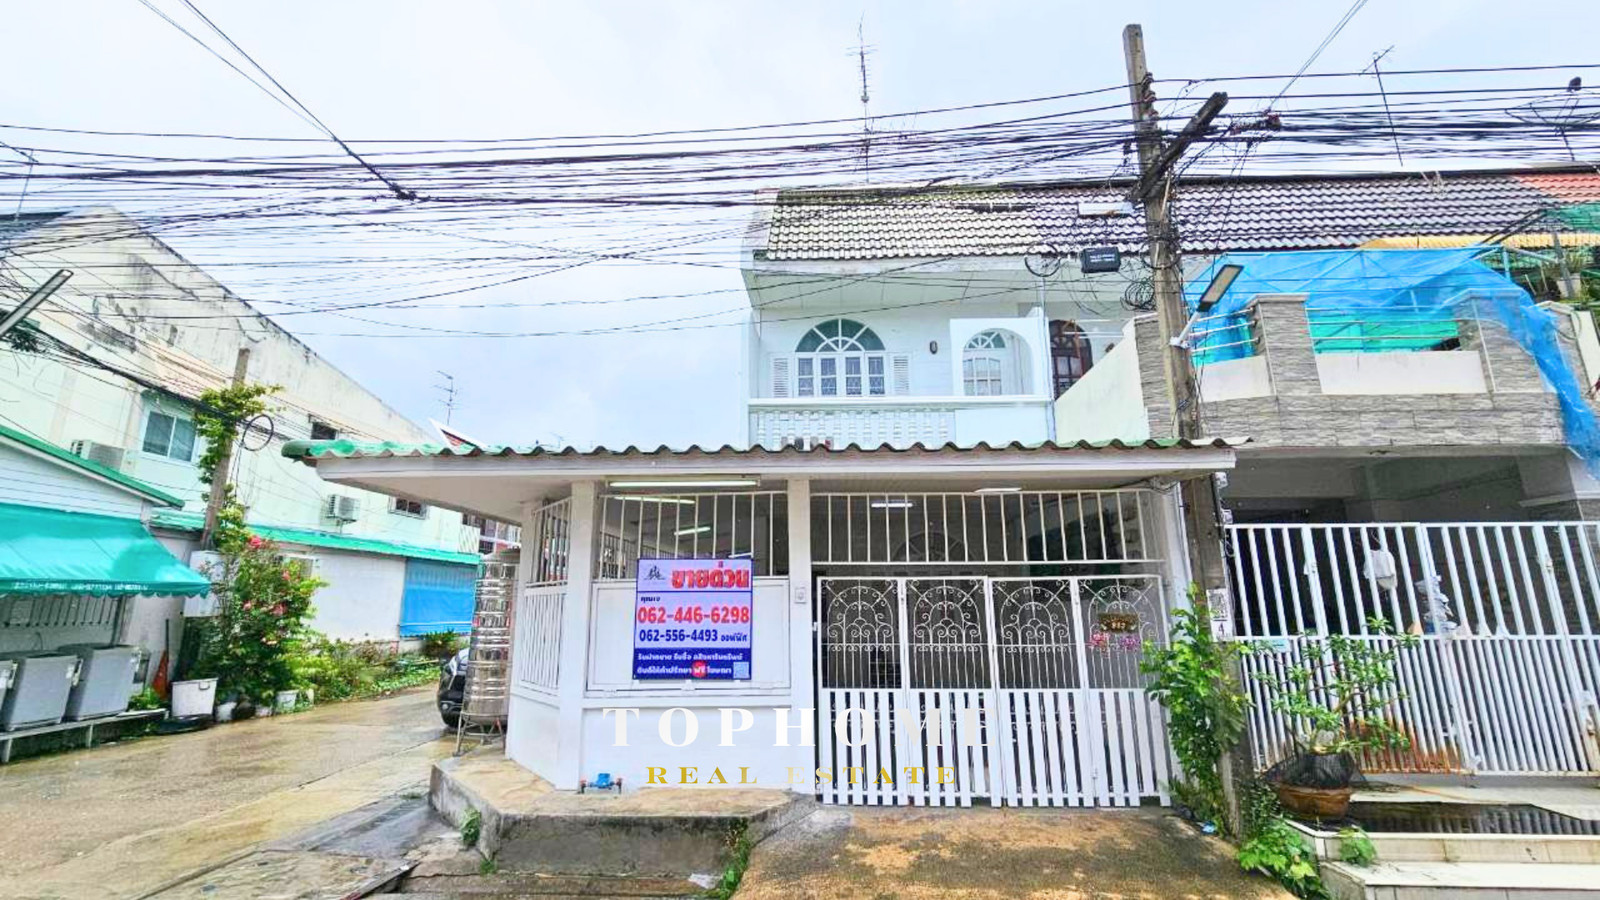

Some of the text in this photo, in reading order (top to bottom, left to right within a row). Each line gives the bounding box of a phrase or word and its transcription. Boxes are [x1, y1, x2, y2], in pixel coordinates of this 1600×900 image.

[671, 561, 750, 589] ขายด่วน
[637, 606, 750, 624] 062-446-6298
[639, 629, 718, 642] 062-556-4493
